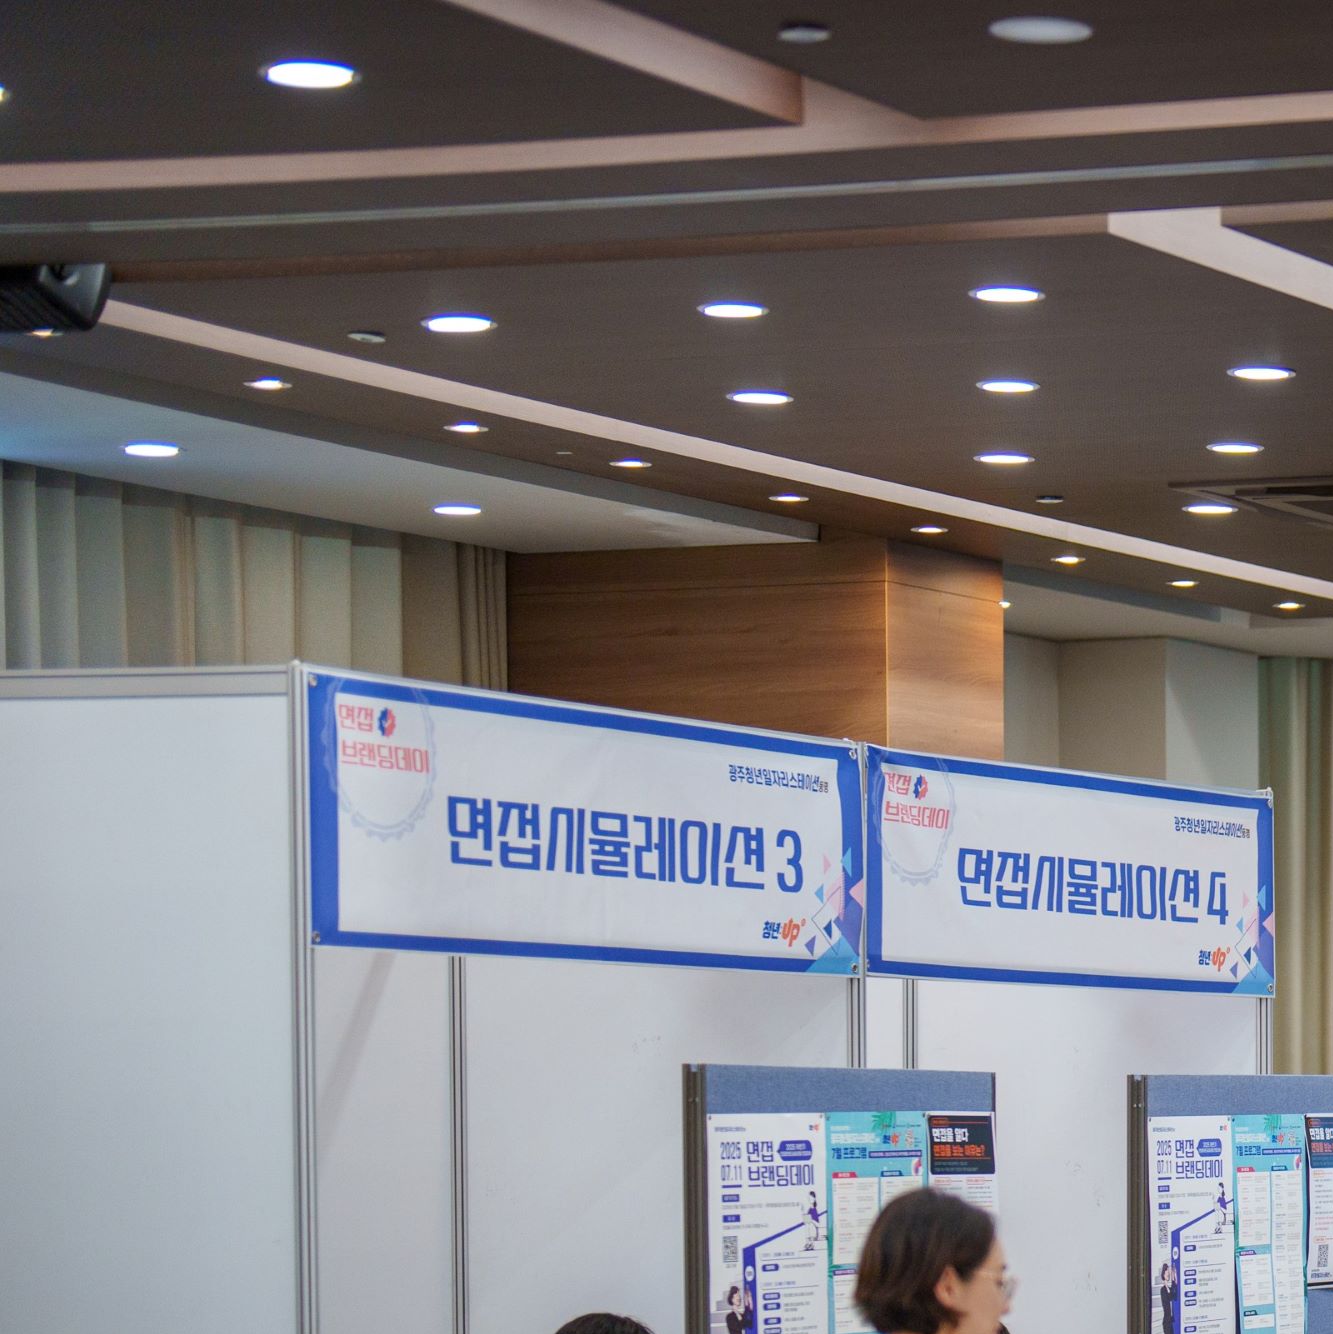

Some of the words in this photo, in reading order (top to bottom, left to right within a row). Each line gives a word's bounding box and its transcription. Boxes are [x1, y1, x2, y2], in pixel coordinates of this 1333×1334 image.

[338, 703, 374, 733] 면접
[341, 739, 430, 775] 브랜딩데이
[884, 800, 950, 830] 브랜딩데이
[446, 795, 766, 891] 면접시뮬레이션
[776, 828, 804, 894] 3
[956, 846, 1201, 925] 면접시뮬레이션
[1206, 870, 1230, 926] 4
[720, 1141, 742, 1160] 2025
[746, 1140, 775, 1163] 면접
[1156, 1140, 1172, 1156] 2025
[1174, 1139, 1195, 1159] 면접
[747, 1163, 815, 1188] 브랜딩데이
[1175, 1159, 1223, 1180] 브랜딩데이
